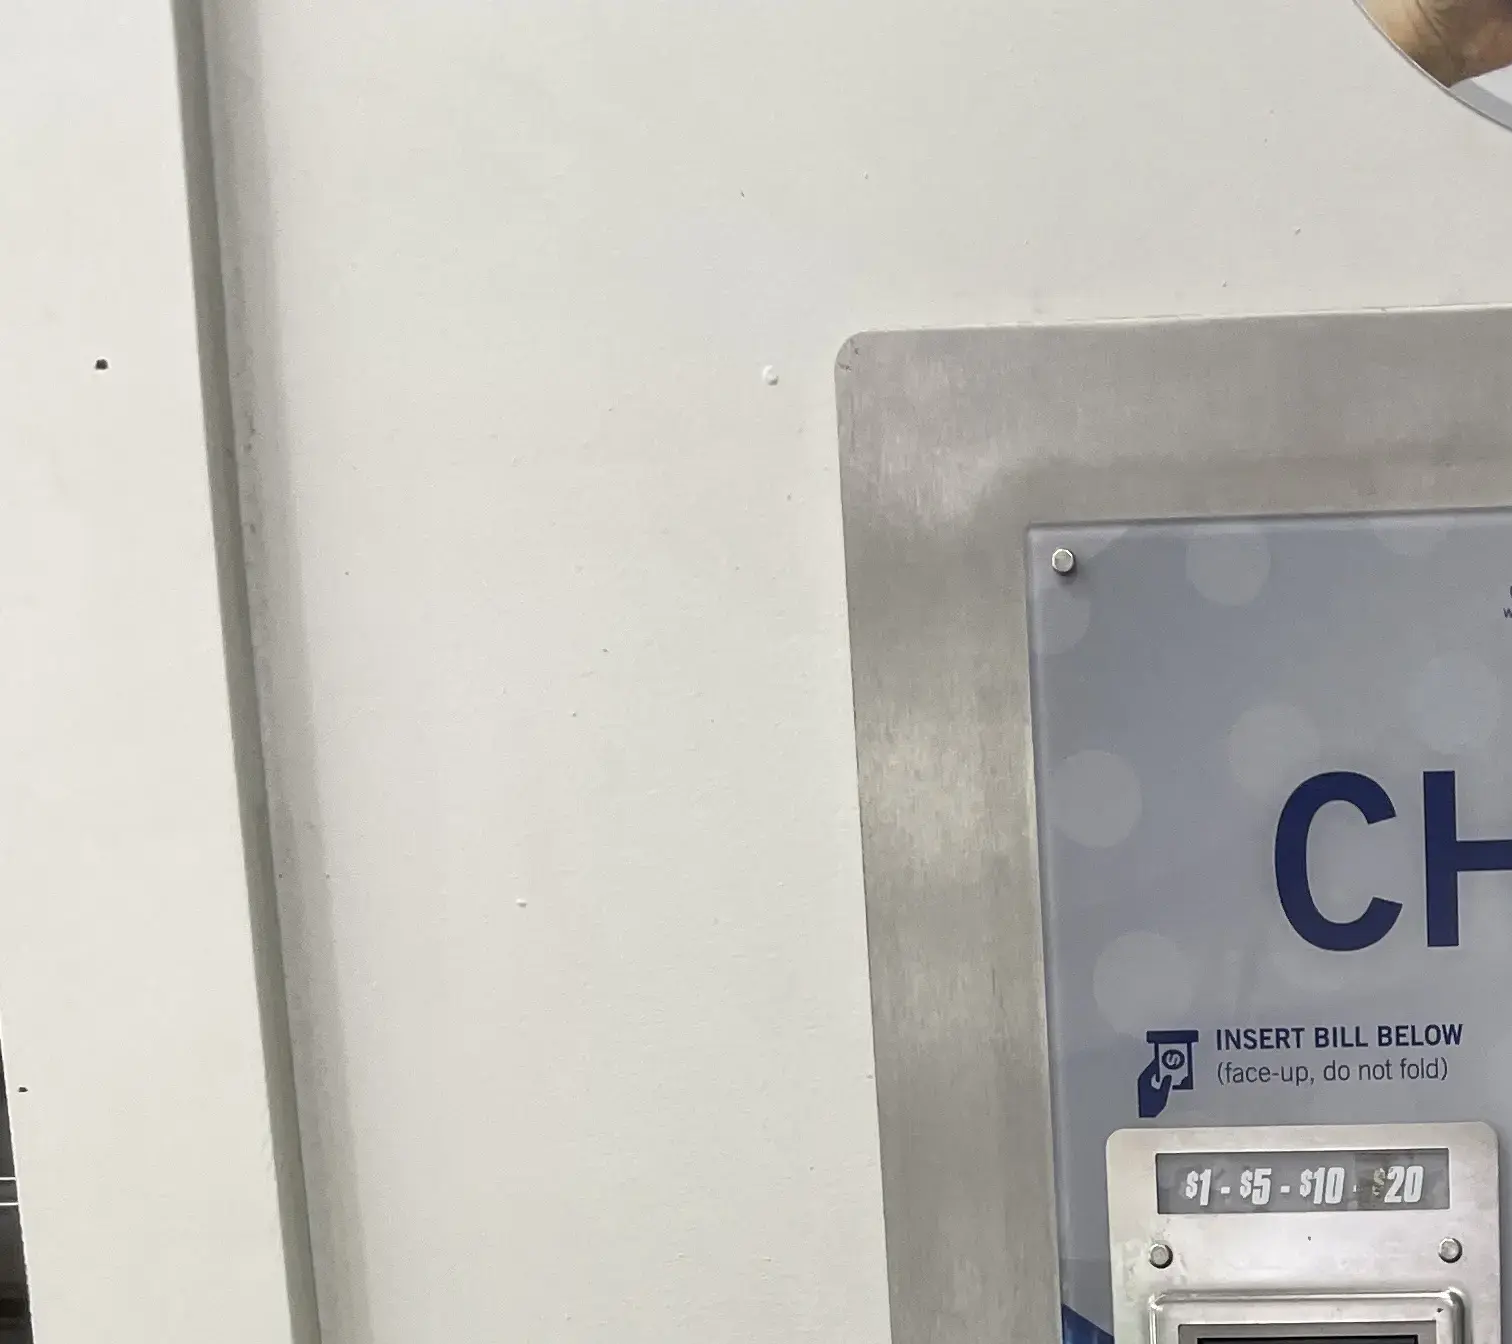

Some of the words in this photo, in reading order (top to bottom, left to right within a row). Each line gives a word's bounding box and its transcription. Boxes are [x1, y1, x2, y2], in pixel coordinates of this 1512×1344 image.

[1215, 1026, 1306, 1052] INSERT
[1313, 1024, 1369, 1049] BILL
[1377, 1022, 1464, 1047] BELOW
[1216, 1060, 1316, 1087] (face-up,
[1323, 1058, 1351, 1082] do
[1358, 1059, 1393, 1081] not
[1400, 1056, 1449, 1082] fold)
[1184, 1167, 1213, 1207] $1
[1239, 1167, 1272, 1206] $5
[1299, 1166, 1346, 1205] $10
